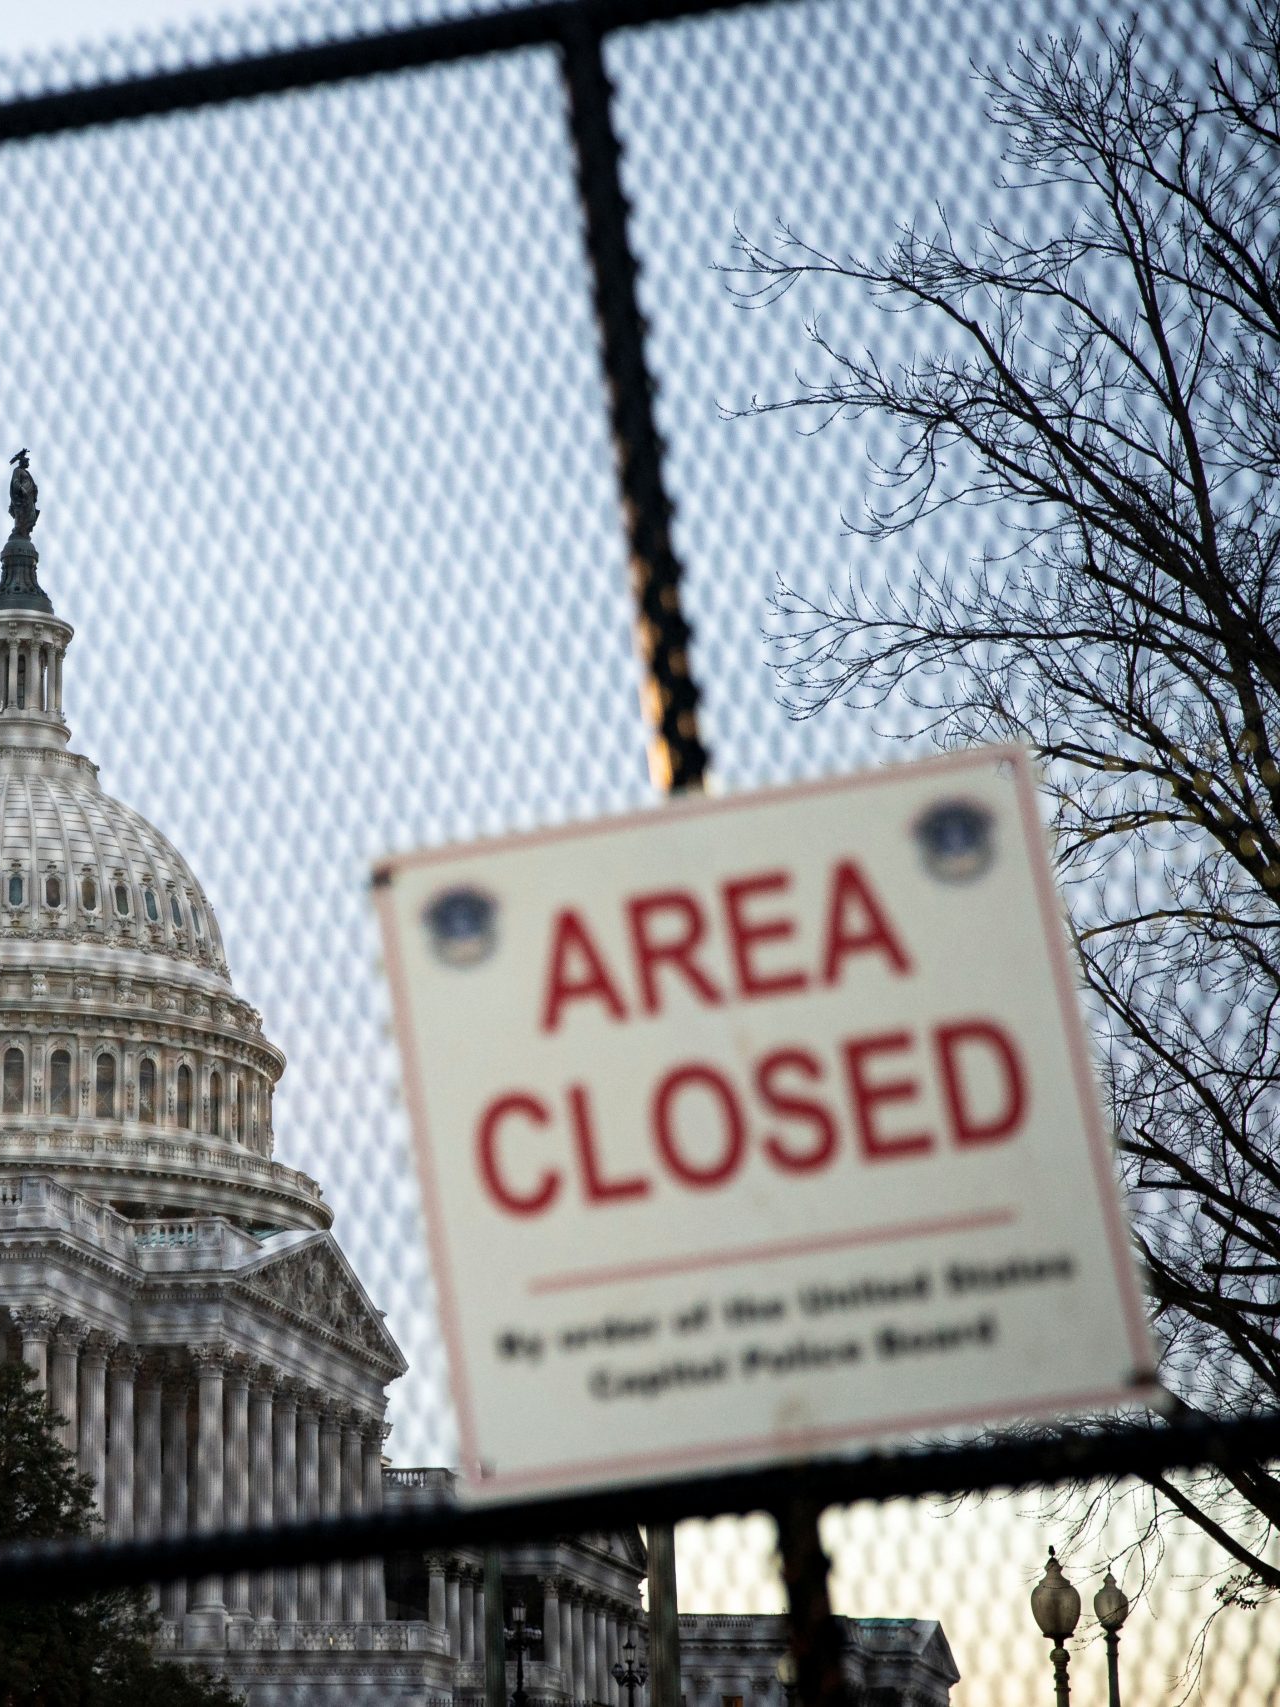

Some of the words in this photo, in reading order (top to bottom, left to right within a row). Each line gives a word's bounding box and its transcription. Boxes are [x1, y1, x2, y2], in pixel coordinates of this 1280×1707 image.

[539, 857, 911, 1035] AREA
[475, 1018, 1028, 1219] CLOSED
[494, 1325, 545, 1363] By
[559, 1314, 659, 1353] order
[673, 1301, 710, 1335] of
[723, 1293, 785, 1326] the
[798, 1270, 931, 1314] United
[946, 1253, 1076, 1295] States
[588, 1358, 728, 1402] Capitol
[740, 1342, 862, 1378] Police
[874, 1312, 999, 1361] Board
